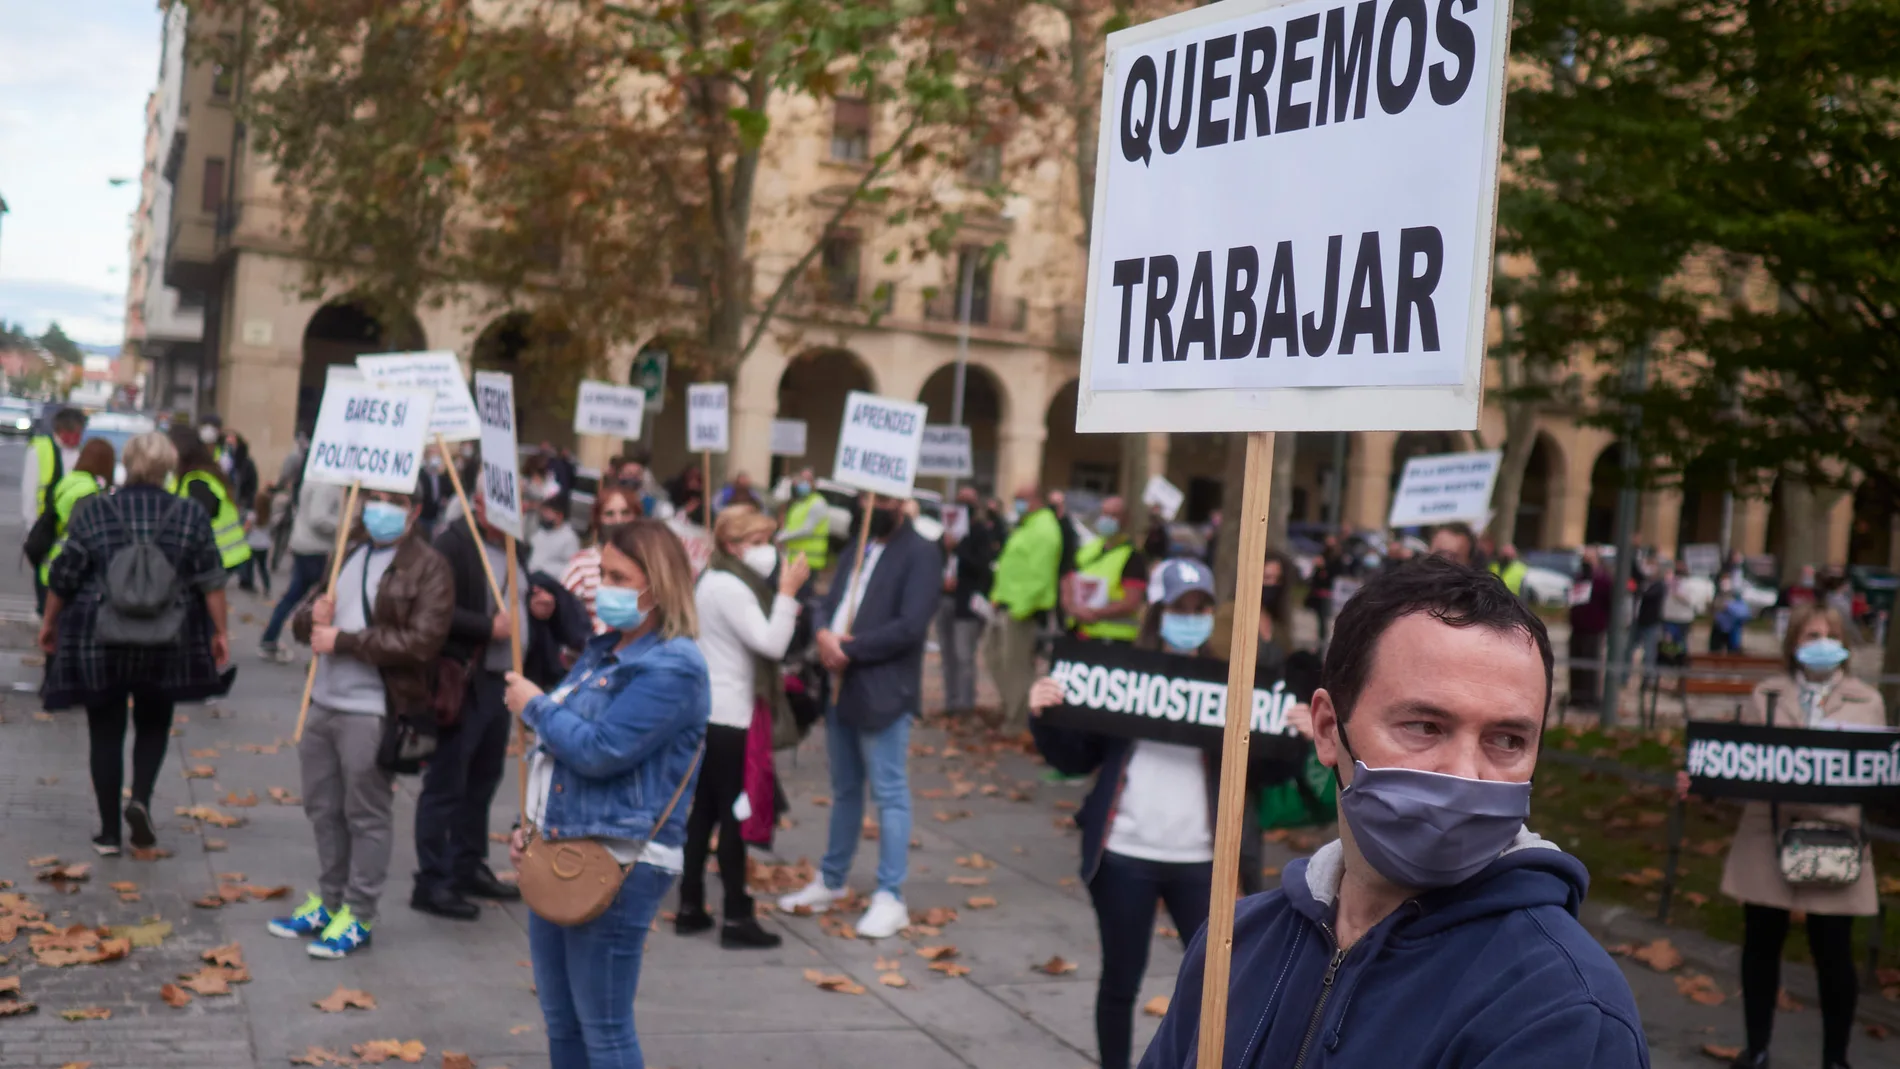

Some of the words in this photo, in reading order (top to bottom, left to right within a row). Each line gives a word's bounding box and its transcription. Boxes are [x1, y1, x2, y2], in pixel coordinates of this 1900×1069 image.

[1120, 0, 1478, 168] QUEREMOS
[1113, 225, 1444, 364] TRABAJAR
[345, 397, 390, 426] BARES
[391, 449, 413, 477] NO
[842, 446, 857, 471] DE
[860, 449, 907, 483] MERKEL
[1688, 738, 1900, 788] #SOSHOSTELERÍ
